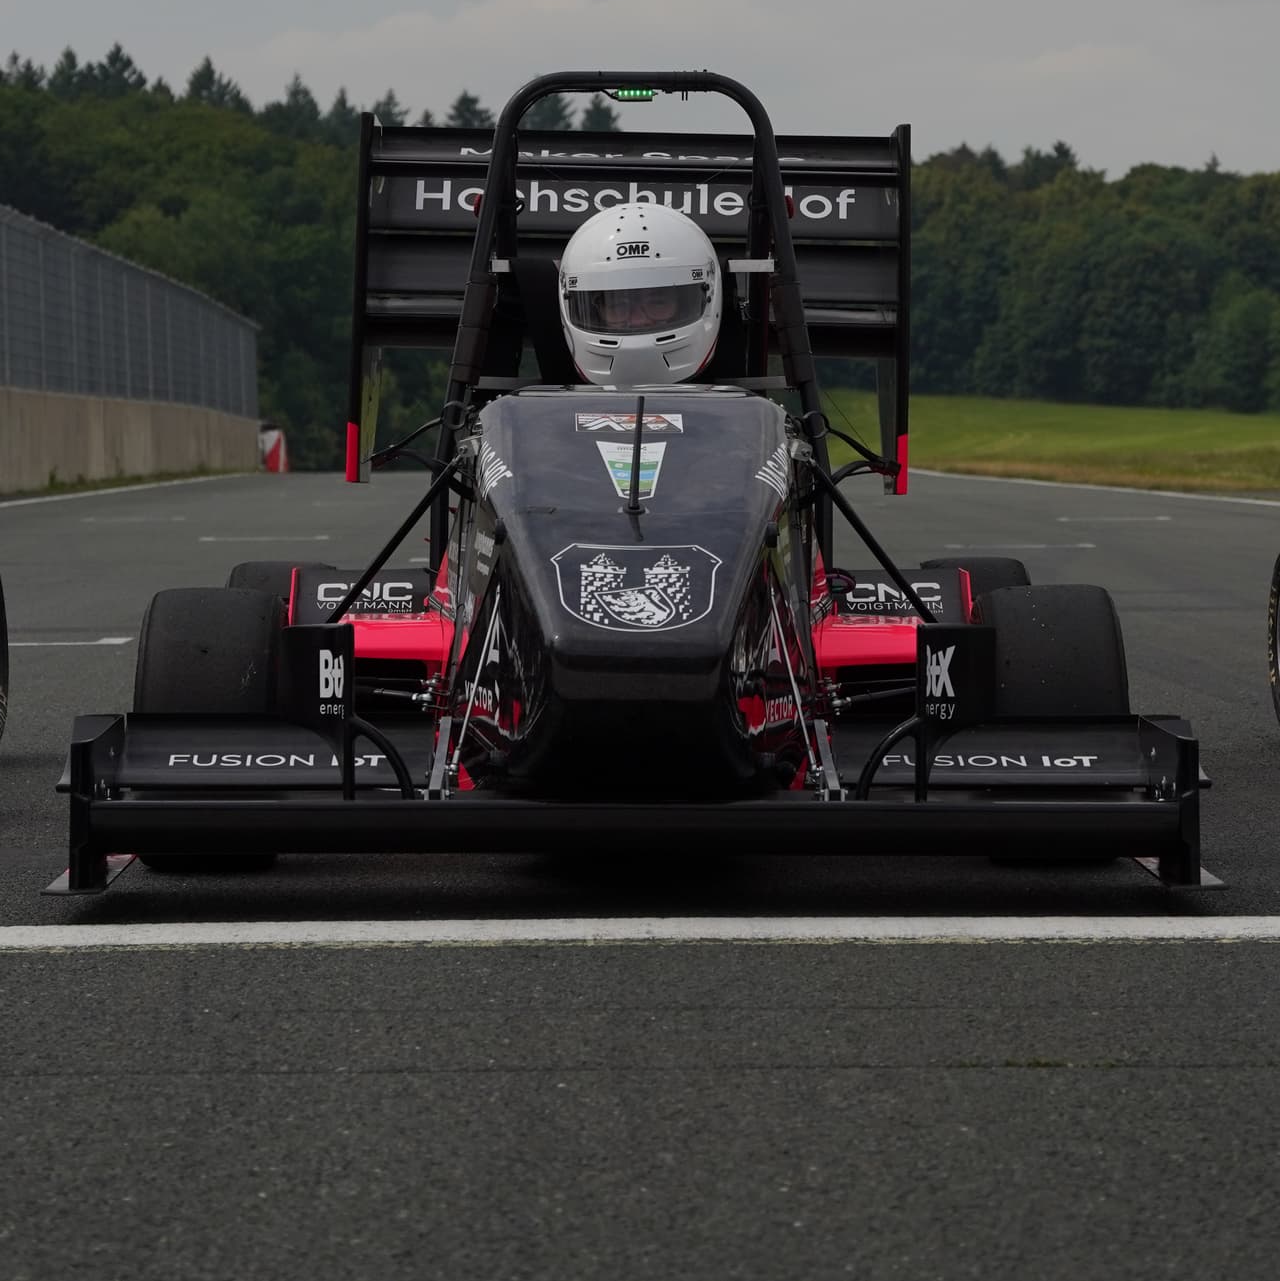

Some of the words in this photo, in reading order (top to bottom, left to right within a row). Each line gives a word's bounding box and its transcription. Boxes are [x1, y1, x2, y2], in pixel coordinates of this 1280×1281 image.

[616, 244, 650, 256] OMP
[169, 753, 315, 767] FUSION
[1041, 755, 1098, 768] IoT
